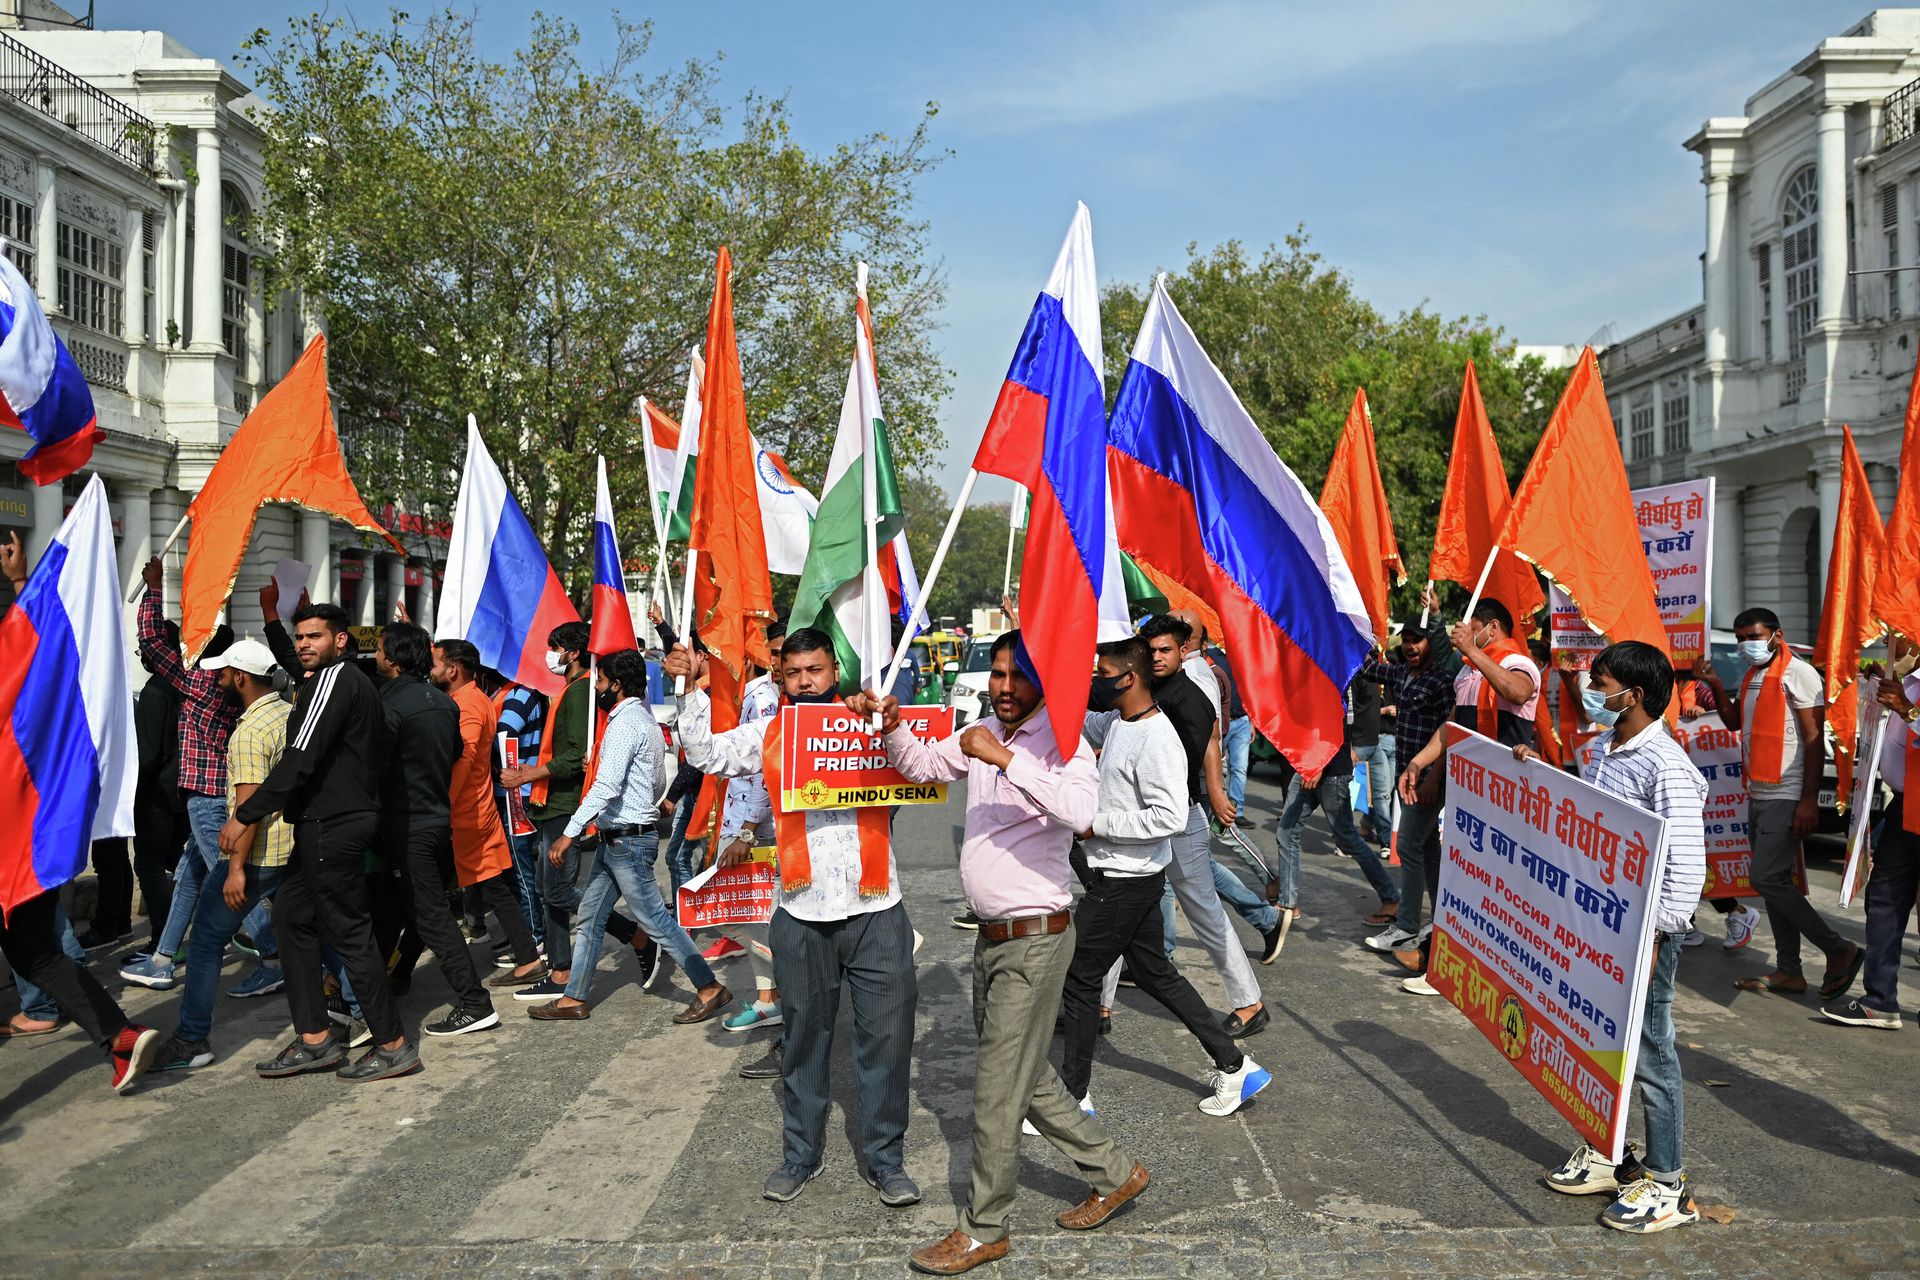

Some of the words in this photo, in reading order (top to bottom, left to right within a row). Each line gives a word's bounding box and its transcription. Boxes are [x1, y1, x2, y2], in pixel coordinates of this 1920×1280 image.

[0, 497, 27, 517] ring
[1686, 492, 1703, 520] हो
[1656, 530, 1694, 554] करों
[1650, 563, 1697, 580] ружба
[1674, 631, 1701, 650] यादव
[806, 737, 863, 753] INDIA
[822, 717, 868, 733] LON
[901, 718, 929, 732] VE
[814, 756, 896, 772] FRIEND
[837, 789, 890, 804] HINDU
[894, 786, 939, 800] SENA
[1450, 752, 1486, 798] भारत
[1518, 775, 1552, 834] मैत्री
[1555, 798, 1621, 885] दीर्घायु
[1622, 831, 1649, 888] हो
[1456, 806, 1486, 852] शत्रु
[1489, 825, 1518, 865] का
[1521, 846, 1570, 898] नाश
[1574, 878, 1629, 934] करों
[1449, 845, 1492, 888] Индия
[1495, 875, 1550, 930] Россия
[1553, 924, 1625, 985] дружба
[1481, 895, 1570, 973] долголетия
[1432, 931, 1466, 1010] हिन्दू
[1467, 959, 1498, 1024] सेना
[1441, 888, 1553, 986] уничтожение
[1558, 979, 1617, 1040] врага
[1445, 911, 1534, 994] Индуистская
[1537, 993, 1594, 1048] армия.
[1530, 1022, 1576, 1086] सुरजीत
[1576, 1063, 1614, 1124] यादव
[1541, 1066, 1607, 1141] 9650268976
